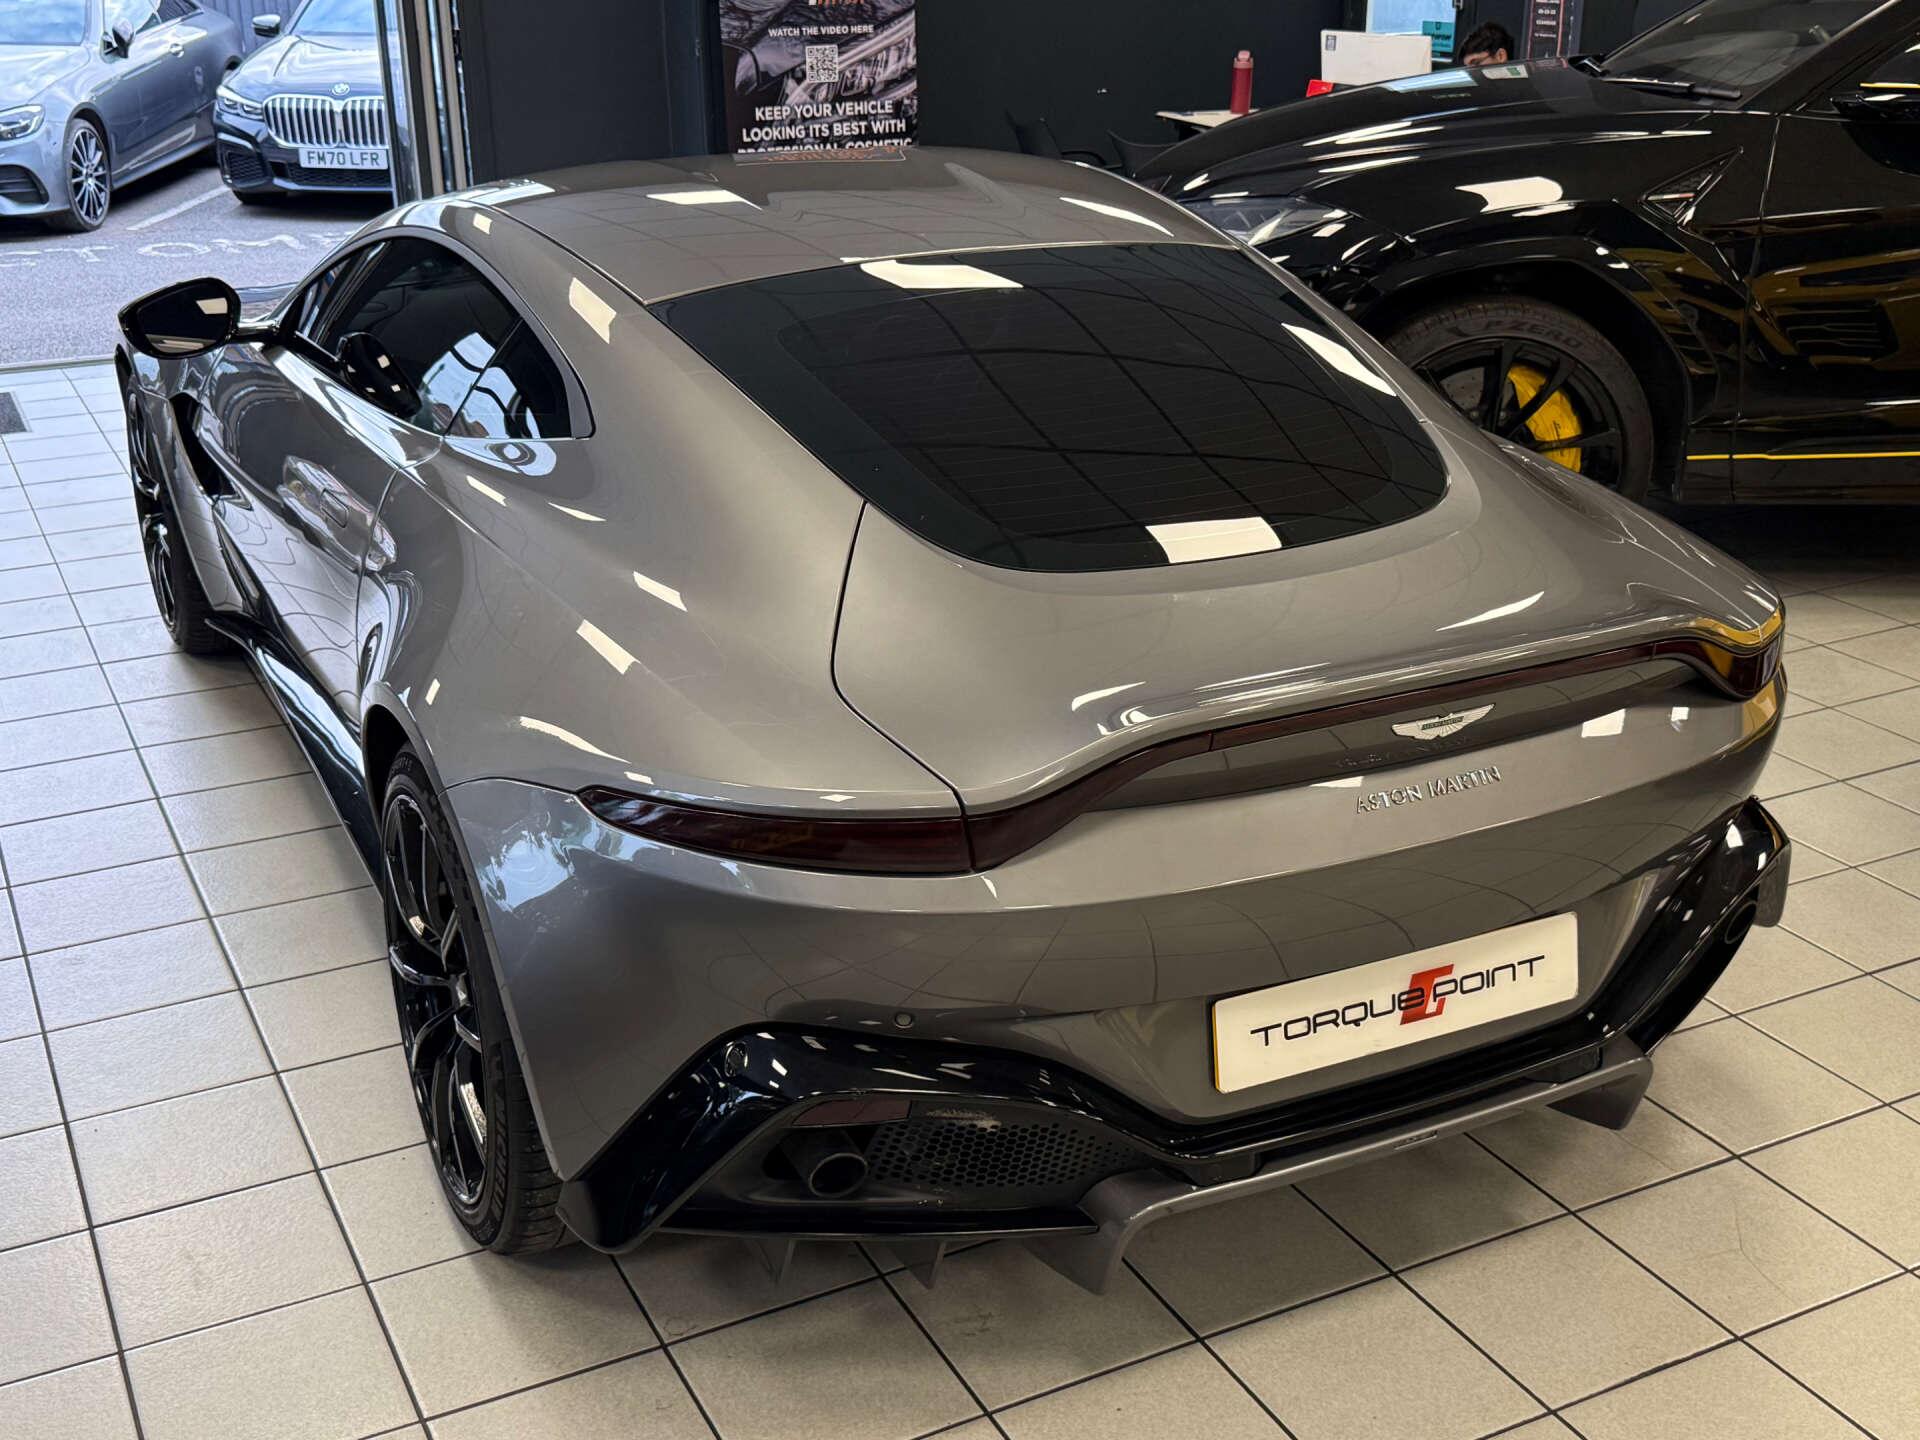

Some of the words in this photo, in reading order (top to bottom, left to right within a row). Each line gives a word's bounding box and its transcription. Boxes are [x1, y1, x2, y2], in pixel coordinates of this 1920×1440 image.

[768, 27, 800, 37] WATCH
[801, 26, 819, 36] THE
[820, 25, 849, 35] VIDEO
[850, 24, 874, 34] HERE
[755, 105, 791, 121] KEEP
[794, 103, 832, 119] YOUR
[835, 99, 893, 116] VEHICLE
[742, 124, 806, 143] LOOKING
[809, 123, 830, 138] ITS
[833, 120, 868, 137] BEST
[870, 118, 906, 135] WITH
[307, 150, 346, 166] FM70
[349, 151, 381, 167] LFR
[1356, 784, 1423, 814] ASTON
[1426, 765, 1501, 799] MARTIN
[1250, 987, 1425, 1047] TORQUE
[1433, 954, 1545, 1002] POINT
